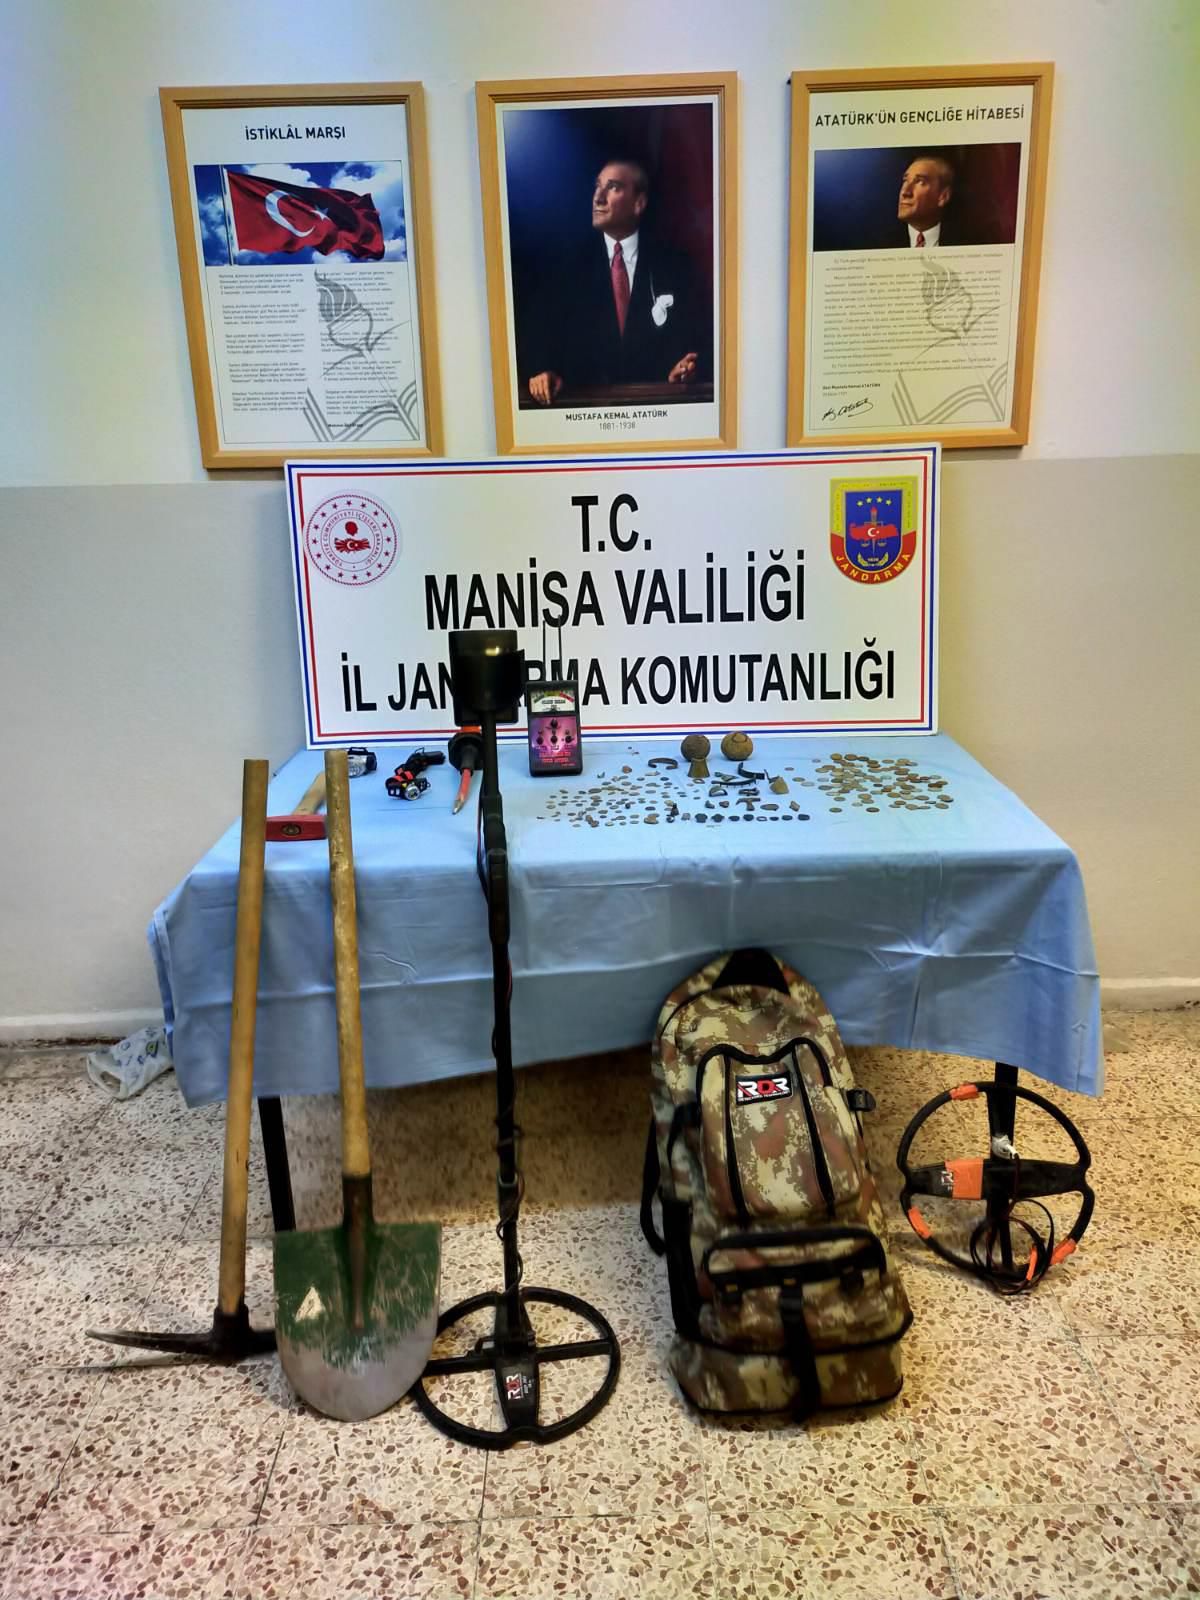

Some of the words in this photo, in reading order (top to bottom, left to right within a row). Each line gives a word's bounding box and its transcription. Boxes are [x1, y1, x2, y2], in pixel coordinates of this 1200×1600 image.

[815, 110, 896, 126] ATATÜRK'ÜN
[900, 106, 962, 124] GENÇLİĞE
[966, 104, 1025, 121] HİTABESİ
[245, 124, 303, 141] İSTİKLÂL
[305, 126, 346, 140] MARŞI
[565, 412, 602, 421] MUSTAFA
[604, 410, 631, 420] KEMAL
[632, 408, 669, 418] ATATÜRK
[600, 421, 636, 431] 1881-1938
[571, 493, 652, 553] T.C.
[835, 553, 912, 583] JANDARMA
[424, 557, 605, 630] MANİSA
[614, 549, 805, 625] VALİLİĞİ
[341, 652, 378, 713] İL
[620, 637, 895, 705] KOMUTANLIĞI
[737, 1077, 790, 1099] RDR
